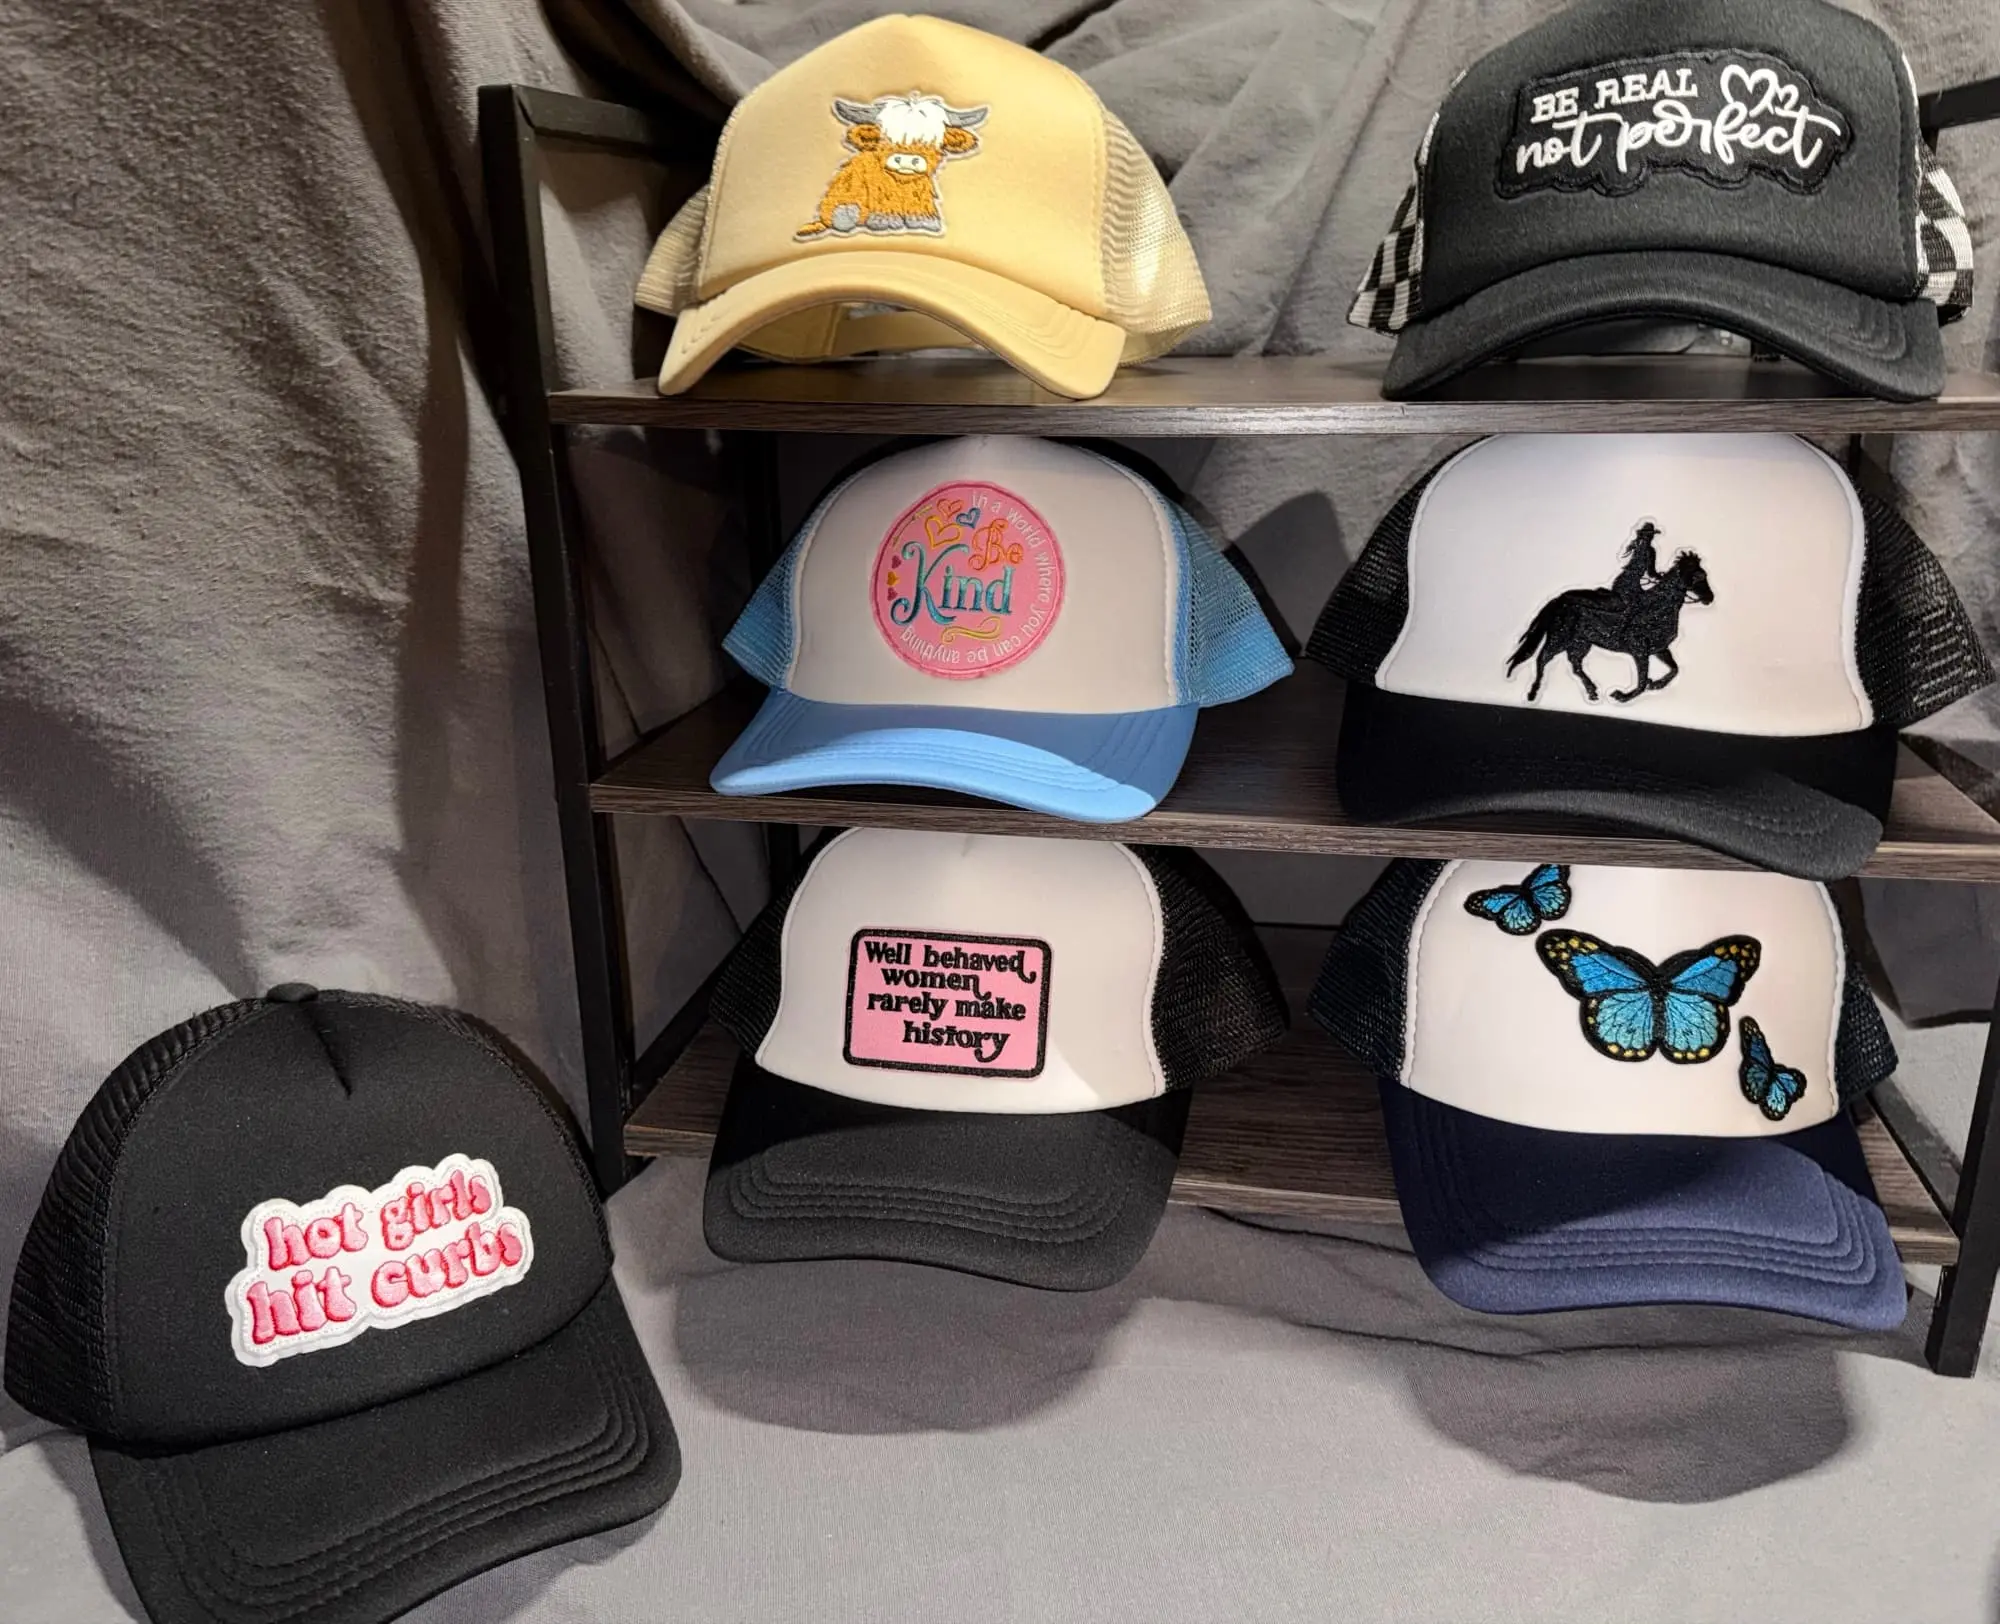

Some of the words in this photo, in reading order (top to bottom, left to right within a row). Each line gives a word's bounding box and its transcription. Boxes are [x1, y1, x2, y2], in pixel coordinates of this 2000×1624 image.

[1530, 87, 1579, 123] BE
[1594, 68, 1699, 109] REAL
[1516, 111, 1623, 174] not
[1616, 99, 1841, 174] perfect
[991, 501, 1001, 514] a
[1007, 507, 1046, 550] world
[968, 518, 1024, 571] Be
[890, 541, 1016, 626] Kind
[1034, 551, 1056, 603] where
[1020, 603, 1047, 638] you
[899, 625, 960, 664] anything
[967, 646, 989, 664] be
[993, 635, 1021, 657] can
[864, 941, 912, 965] Well
[923, 944, 1037, 984] behaved
[881, 968, 992, 1000] women
[866, 991, 950, 1021] rarely
[954, 997, 1027, 1021] make
[902, 1020, 1011, 1063] history
[264, 1202, 369, 1271] hot
[380, 1169, 492, 1251] girls
[246, 1266, 357, 1345] hit
[370, 1221, 523, 1308] curbs
